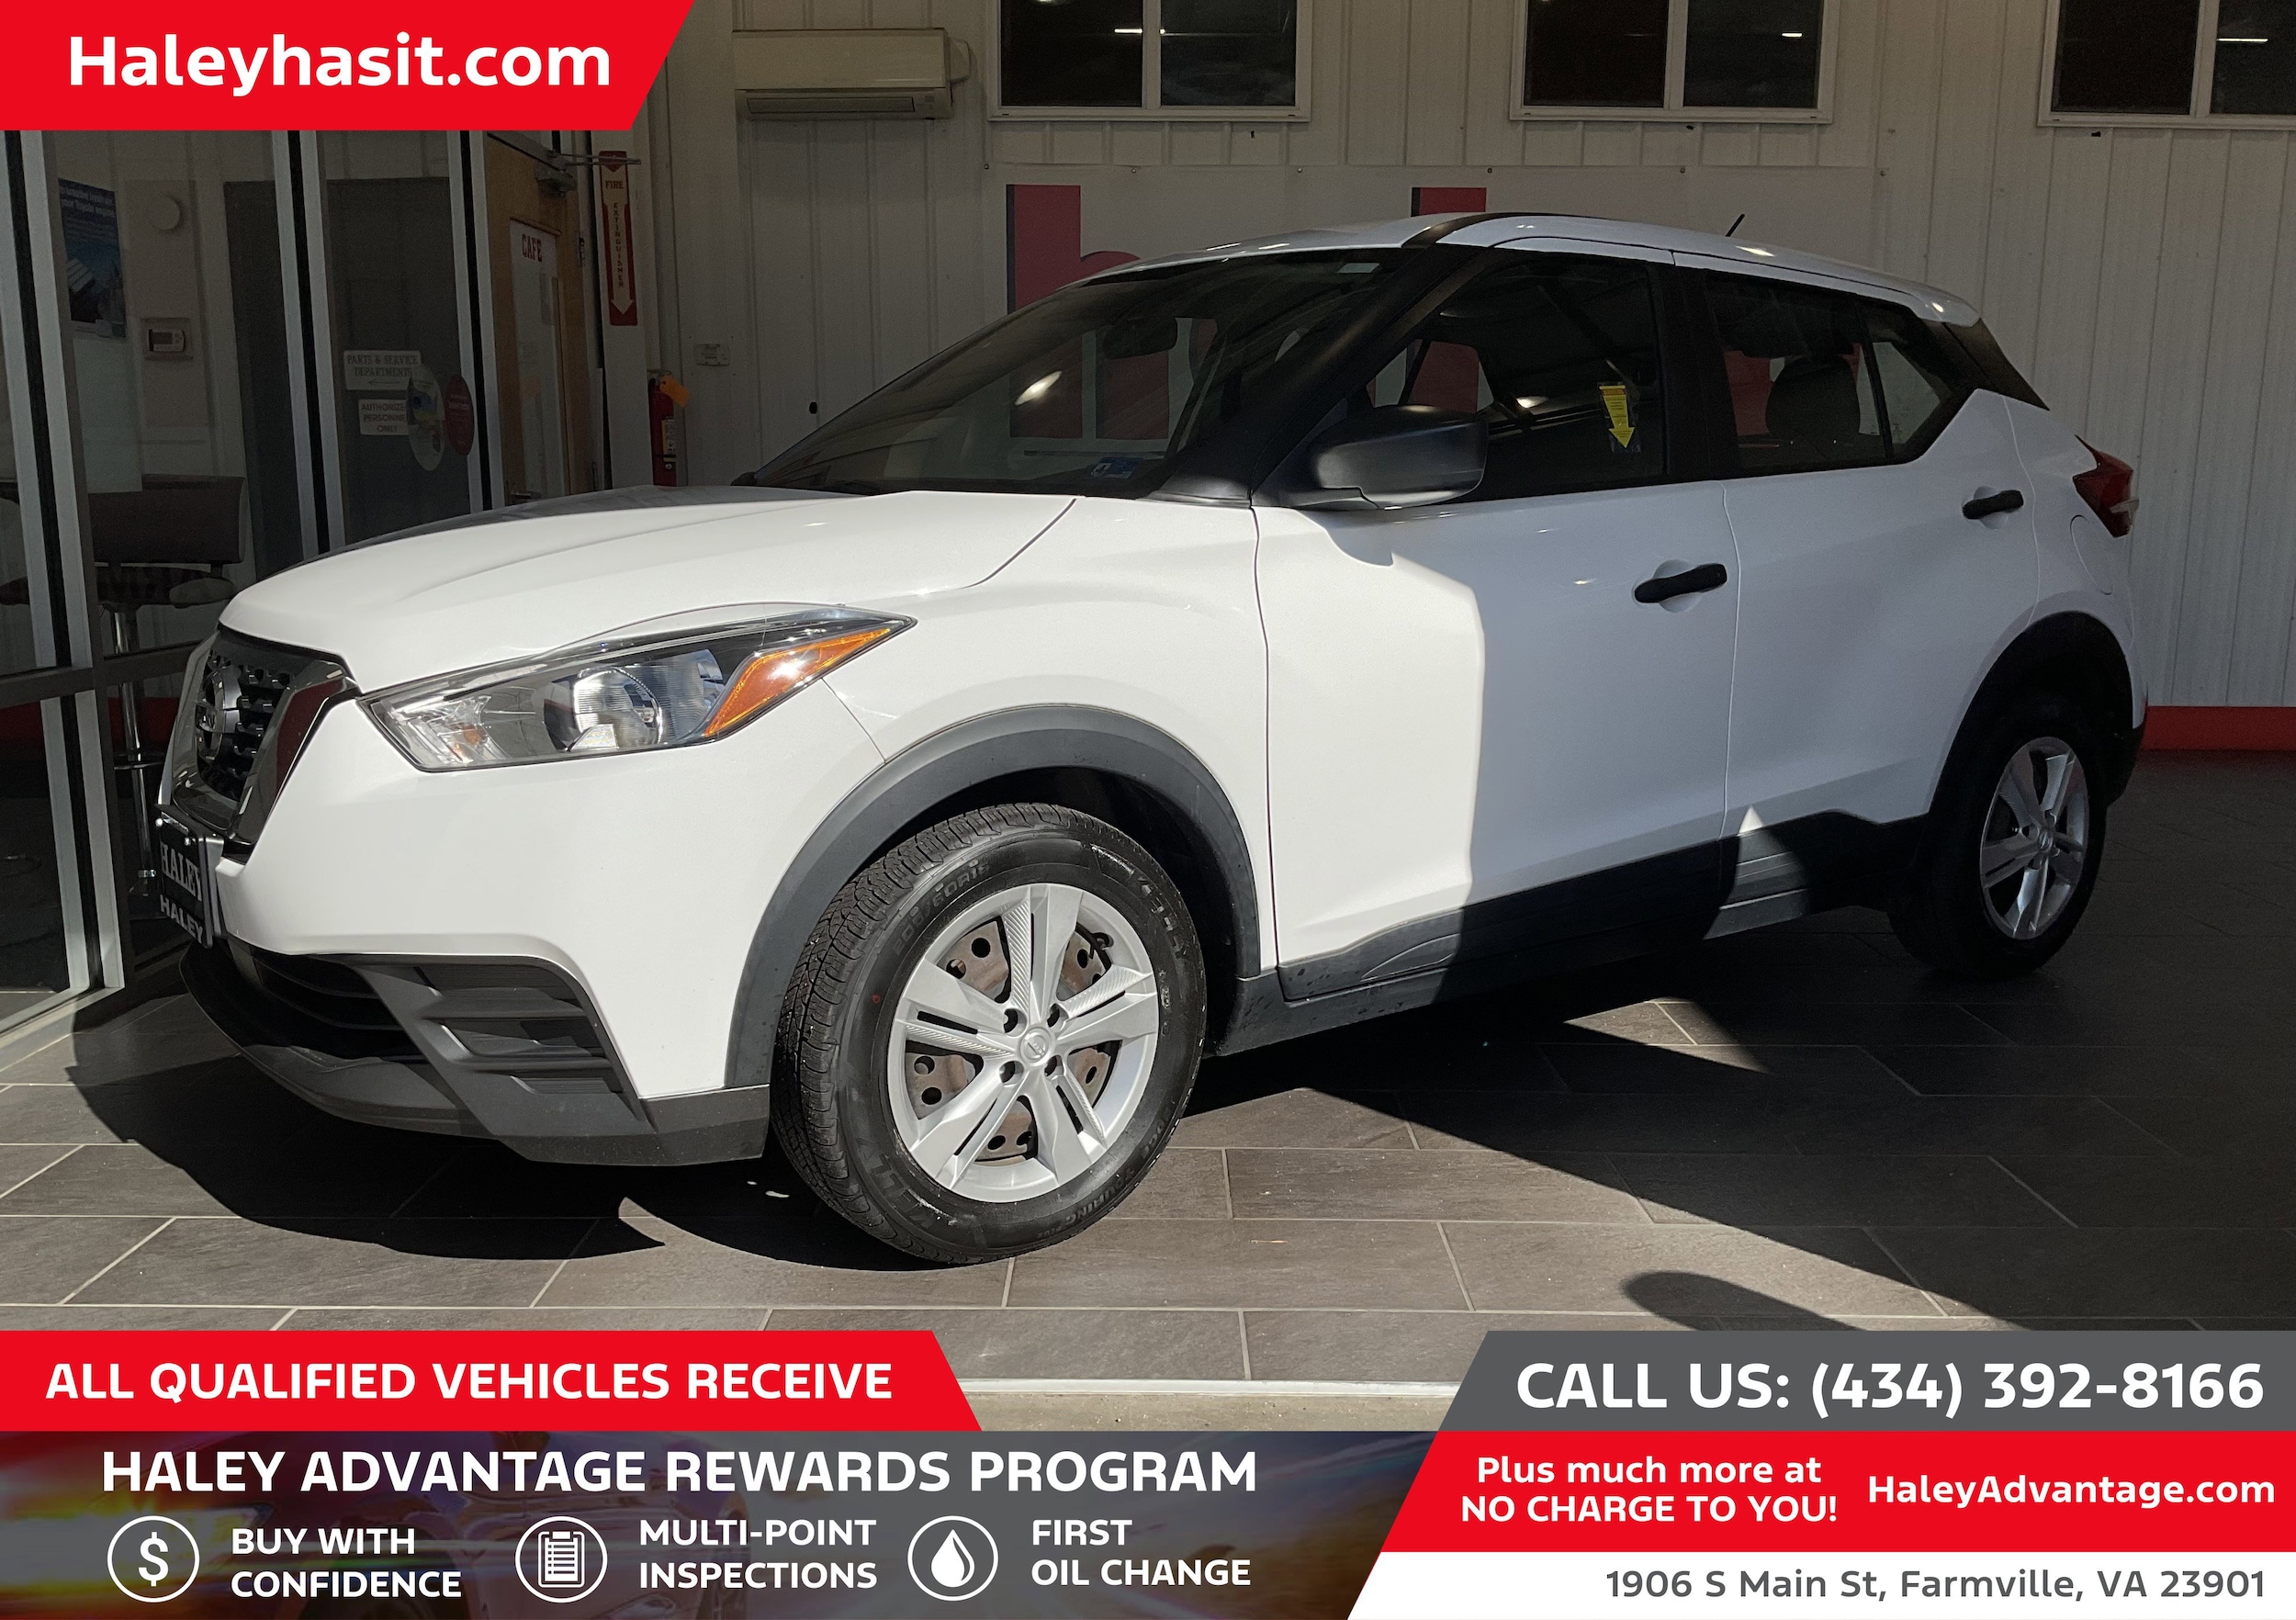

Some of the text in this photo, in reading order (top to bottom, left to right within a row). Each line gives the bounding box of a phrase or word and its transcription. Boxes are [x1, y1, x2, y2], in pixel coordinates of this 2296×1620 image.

[605, 180, 624, 189] FIRE
[522, 233, 543, 263] CAFE
[347, 354, 373, 365] PARTS
[384, 354, 420, 365] SERVICE
[355, 367, 412, 377] DEPARTMENTS
[361, 402, 406, 411] AUTHORIZE
[377, 424, 399, 433] ONLY
[160, 842, 203, 902] HALEY
[160, 894, 205, 944] HALEY
